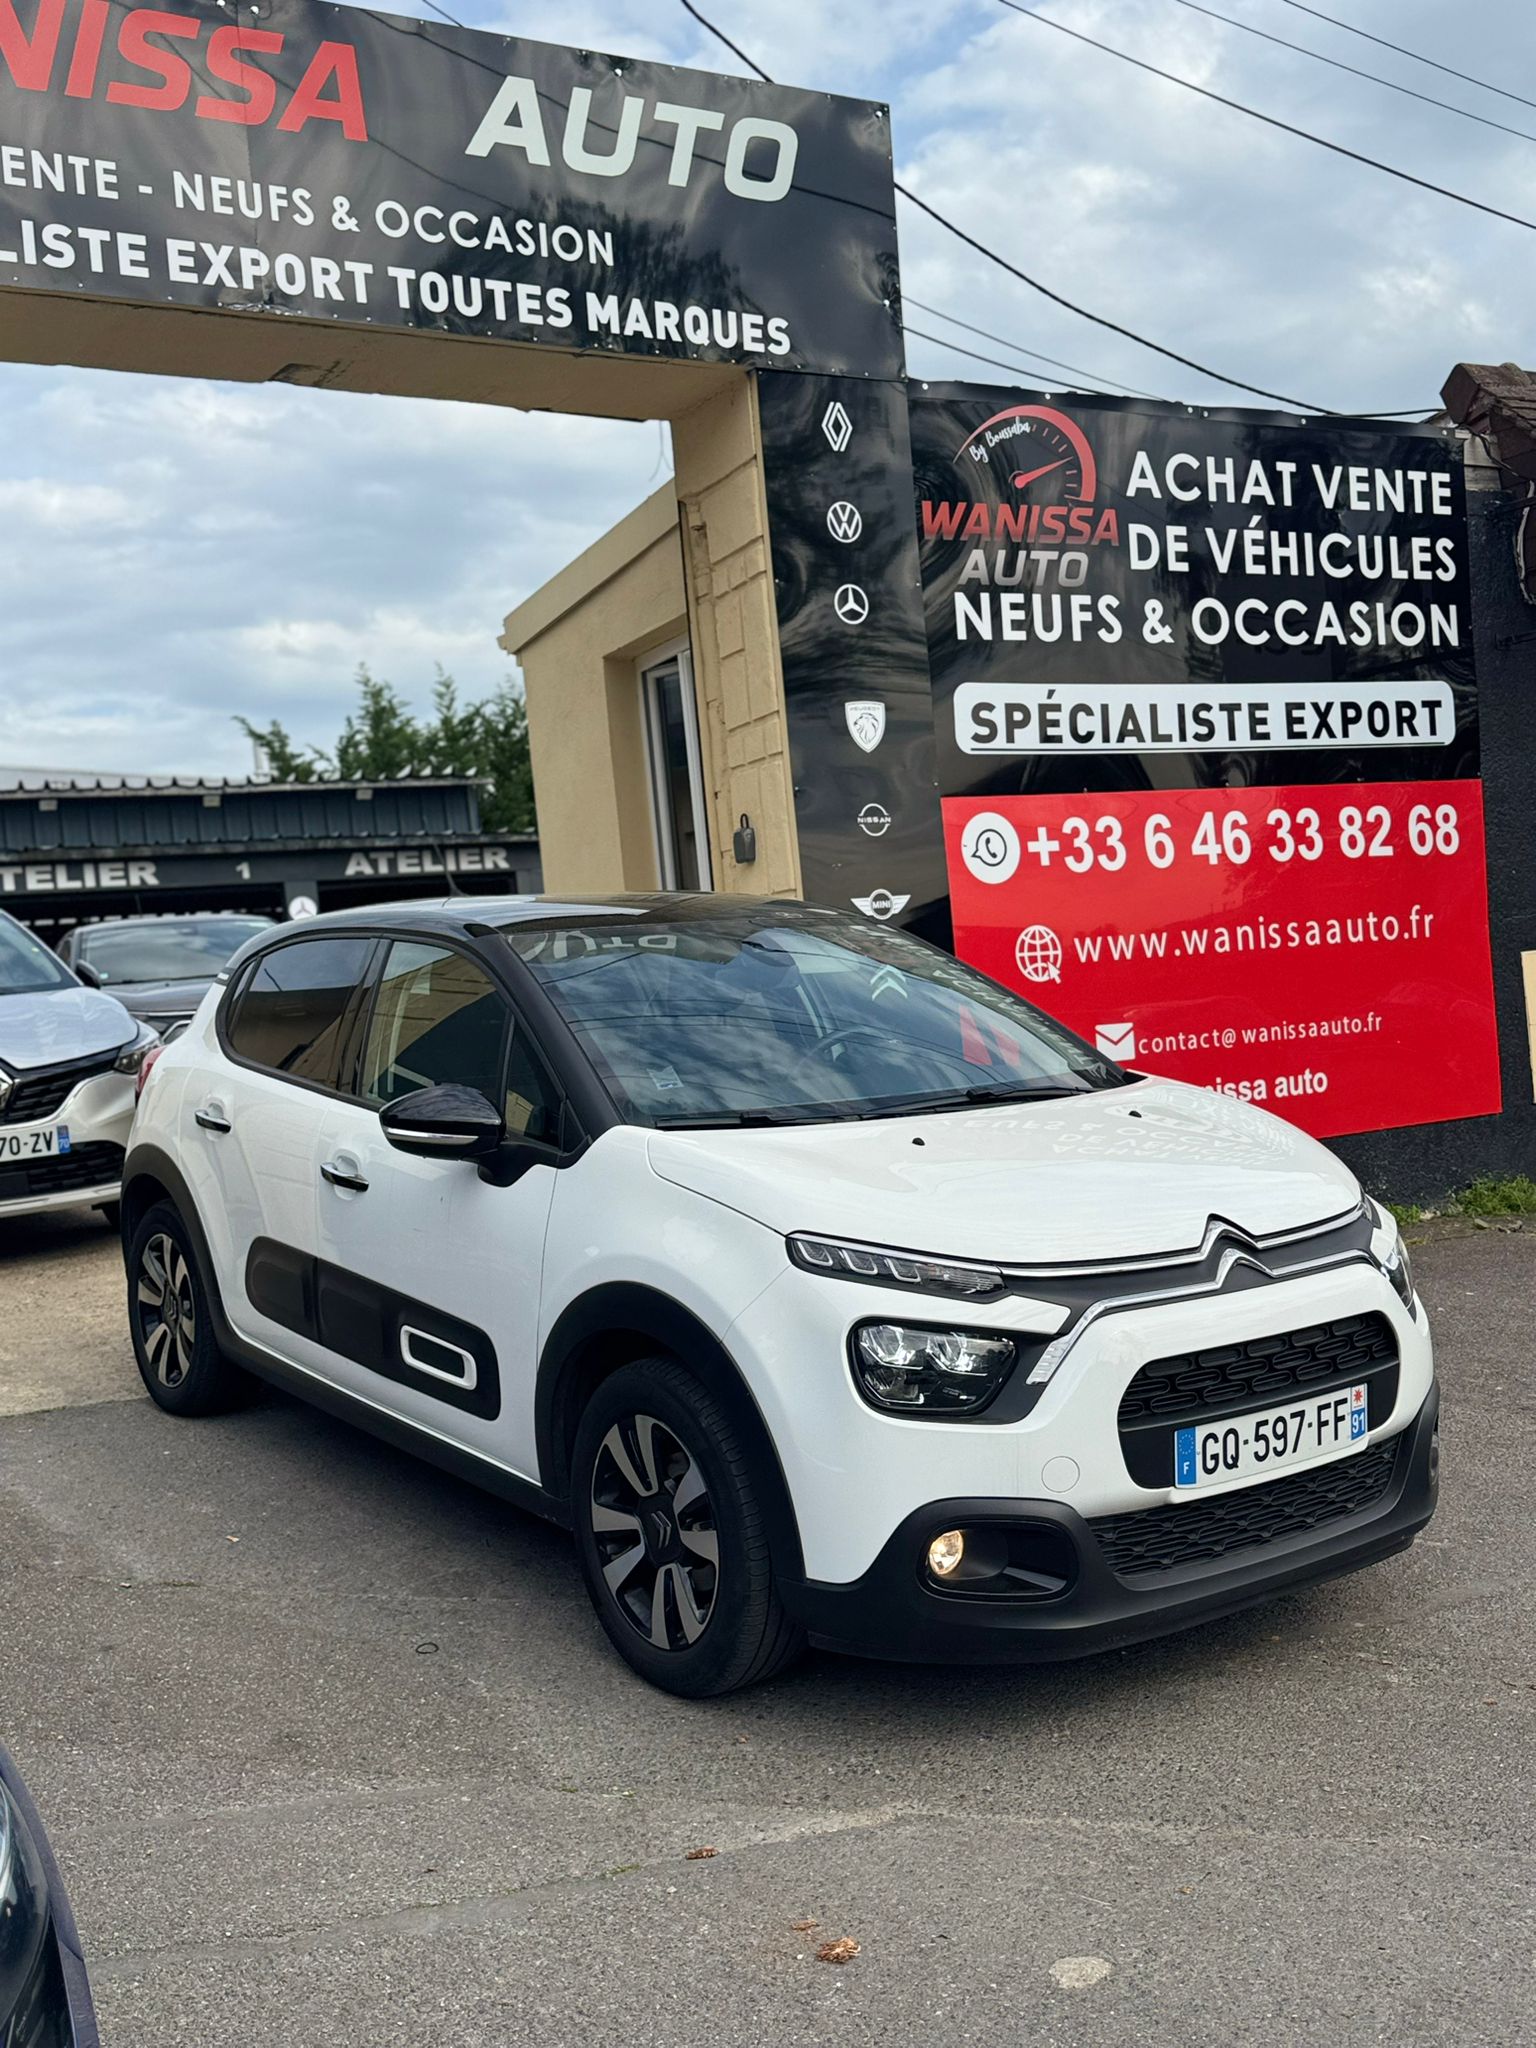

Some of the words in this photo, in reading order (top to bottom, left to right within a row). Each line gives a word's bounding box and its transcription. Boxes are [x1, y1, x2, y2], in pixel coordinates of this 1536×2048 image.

[465, 75, 798, 202] AUTO
[173, 170, 314, 226] NEUFS
[331, 195, 360, 233] &
[375, 199, 614, 267] OCCASION
[166, 238, 374, 304] EXPORT
[387, 266, 573, 329] TOUTES
[586, 291, 791, 356] MARQUES
[1126, 450, 1298, 507] ACHAT
[1312, 463, 1453, 515] VENTE
[922, 500, 1120, 547] WANISSA
[1128, 524, 1190, 572] DE
[1205, 515, 1457, 582] VÉHICULES
[957, 549, 1089, 588] AUTO
[954, 591, 1123, 643] NEUFS
[1143, 597, 1174, 644] &
[1191, 597, 1460, 647] OCCASION
[971, 688, 1271, 744] SPÉCIALISTE
[1286, 700, 1443, 741] EXPORT
[345, 847, 510, 876] ATELIER
[1027, 815, 1127, 873] +33
[1144, 813, 1175, 869] 6
[1191, 810, 1251, 865] 46
[1268, 807, 1324, 862] 33
[1339, 804, 1394, 858] 82
[1407, 803, 1460, 856] 68
[235, 862, 250, 880] 1
[872, 899, 891, 909] MINI
[1074, 904, 1434, 963] www.wanissaauto.fr
[1241, 1012, 1383, 1044] wanissaauto.fr
[1203, 1076, 1267, 1101] issa
[1274, 1068, 1329, 1098] auto
[1202, 1397, 1348, 1475] GQ-597-FF
[1352, 1411, 1365, 1434] 91
[1183, 1461, 1190, 1475] F
